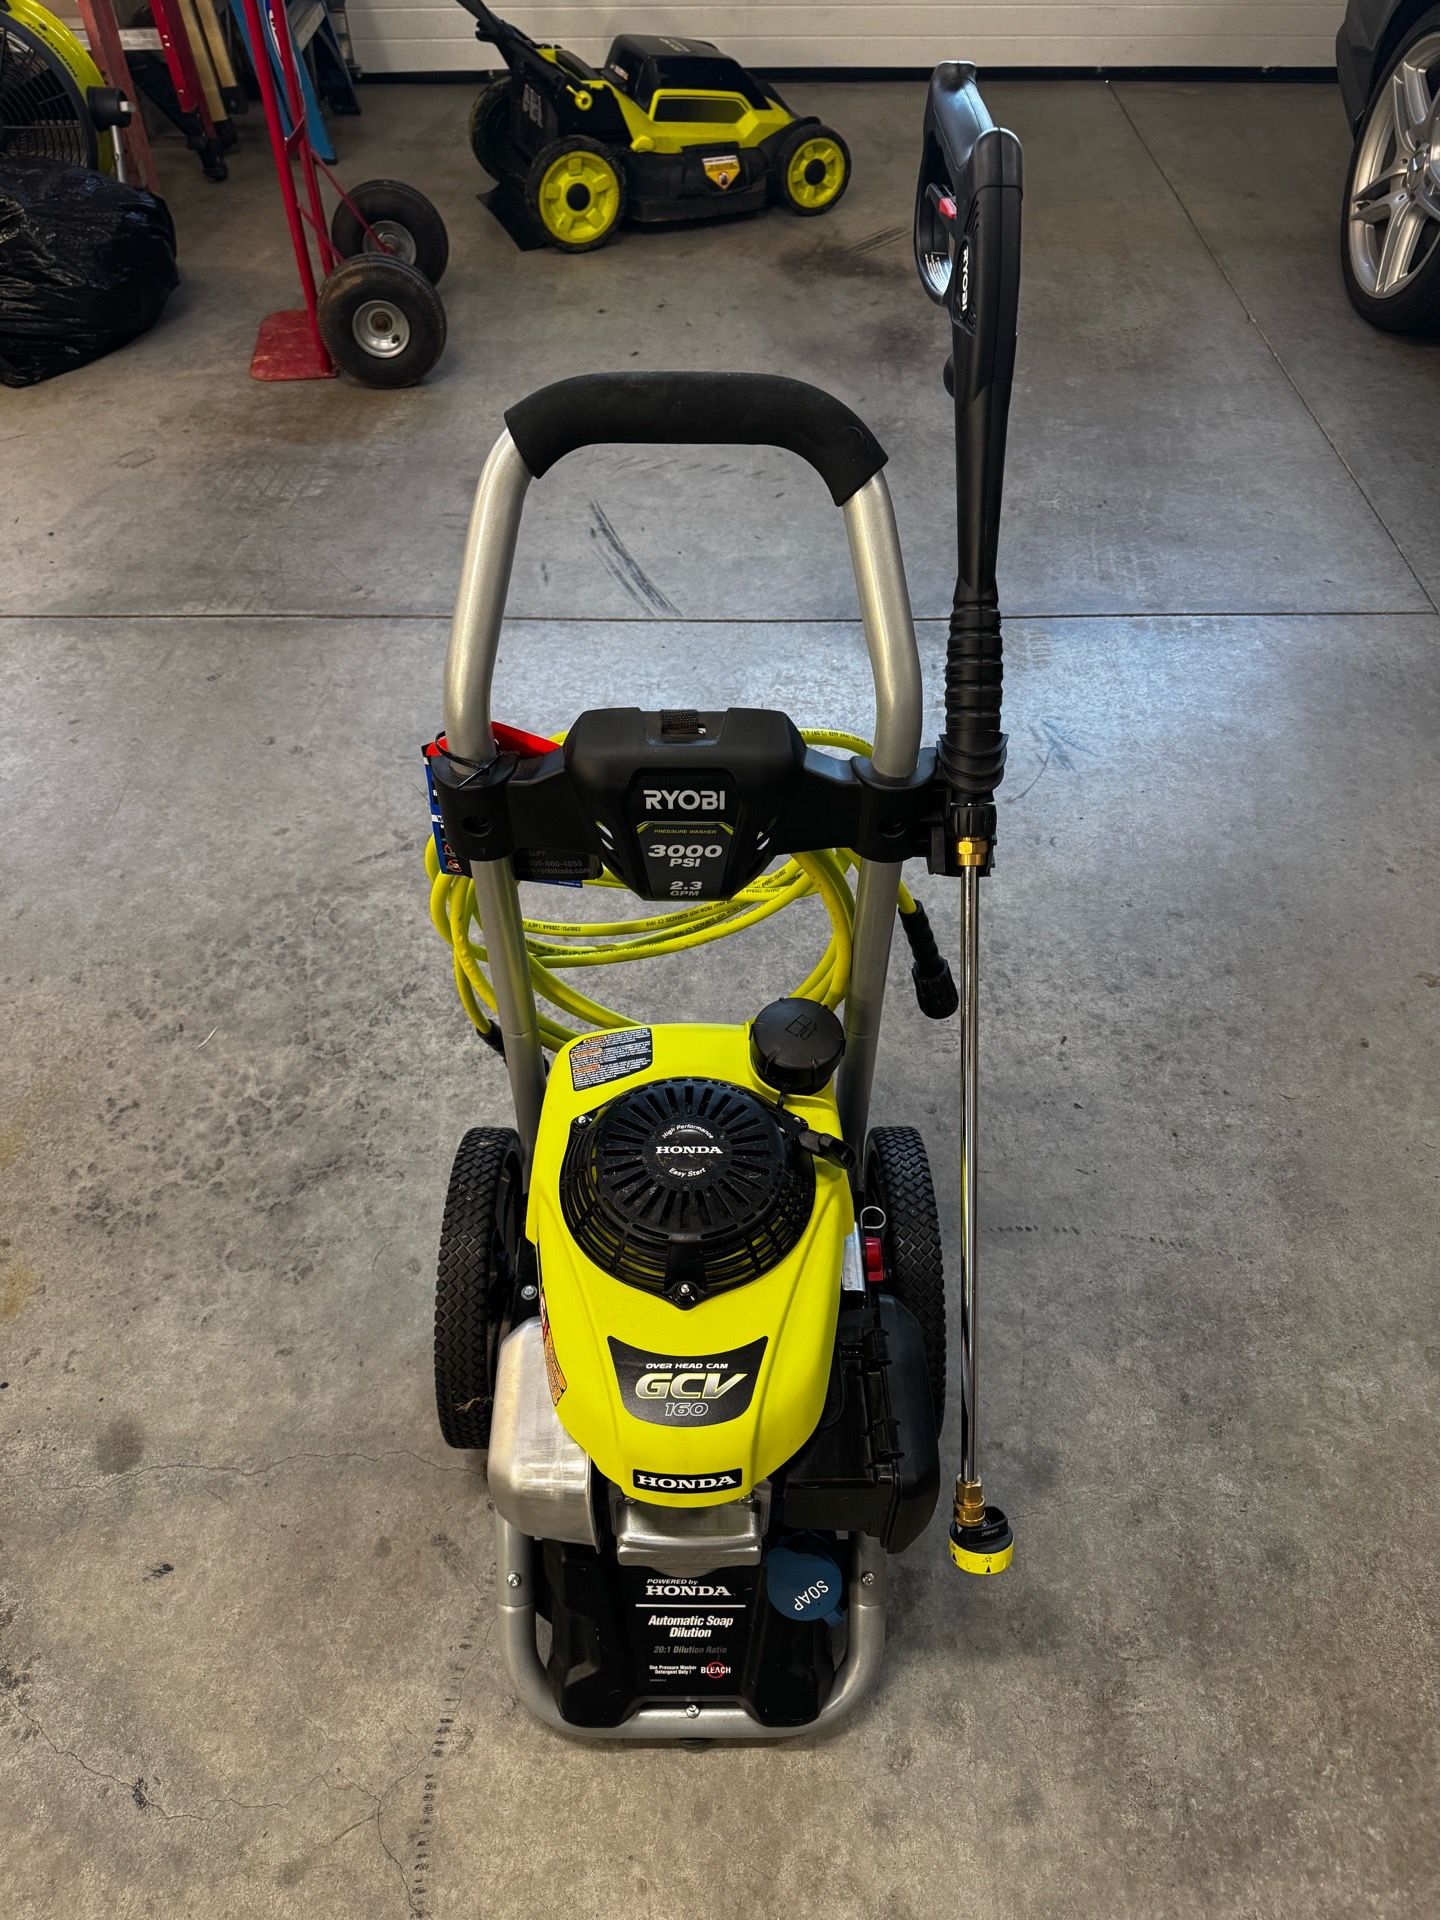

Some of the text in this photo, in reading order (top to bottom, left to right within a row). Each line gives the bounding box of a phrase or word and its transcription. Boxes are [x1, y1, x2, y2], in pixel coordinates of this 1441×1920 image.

[643, 789, 726, 810] RYOBI
[647, 844, 723, 858] 3000
[669, 858, 701, 868] PSI
[669, 880, 703, 891] 2.3
[661, 1124, 714, 1139] High Performance
[655, 1145, 724, 1154] HONDA
[668, 1167, 706, 1178] Easy Start
[635, 1372, 749, 1399] GCV
[665, 1402, 709, 1417] 160
[636, 1474, 738, 1489] HONDA
[645, 1585, 732, 1596] HONDA
[794, 1580, 829, 1611] SOAP
[648, 1615, 734, 1628] Automatic Soap
[669, 1627, 712, 1638] Dilution
[653, 1645, 728, 1654] 20:1 Dilution Ratio
[700, 1666, 732, 1674] BLEACH
